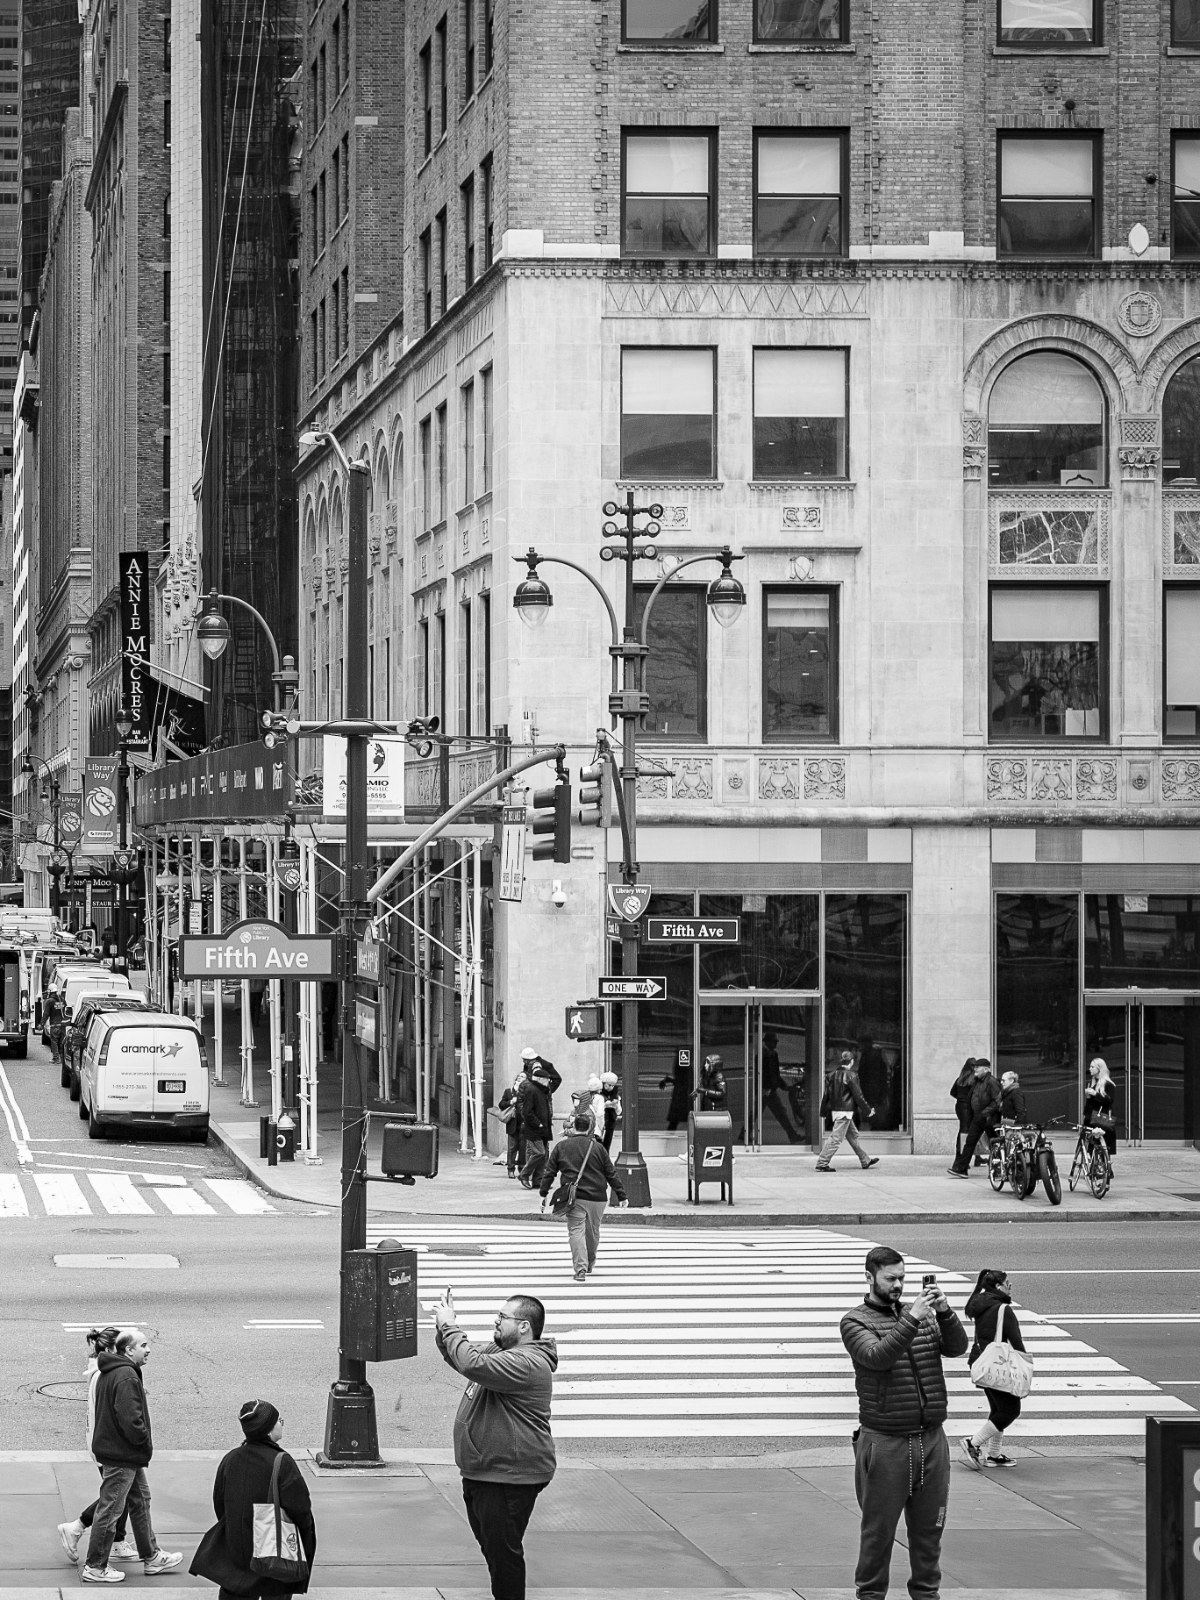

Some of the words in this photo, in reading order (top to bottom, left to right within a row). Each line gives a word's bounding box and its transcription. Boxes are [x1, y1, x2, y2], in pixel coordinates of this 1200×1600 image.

[125, 558, 144, 630] ANNIE
[87, 763, 116, 773] Library
[92, 772, 110, 781] Way
[61, 796, 81, 804] Library
[615, 887, 635, 895] Library
[635, 888, 648, 896] Way
[662, 924, 695, 937] Fifth
[698, 924, 724, 937] Ave
[204, 946, 257, 968] Fifth
[264, 946, 309, 968] Ave
[607, 984, 627, 993] ONE
[635, 984, 656, 993] WAY
[121, 1044, 166, 1054] aramark
